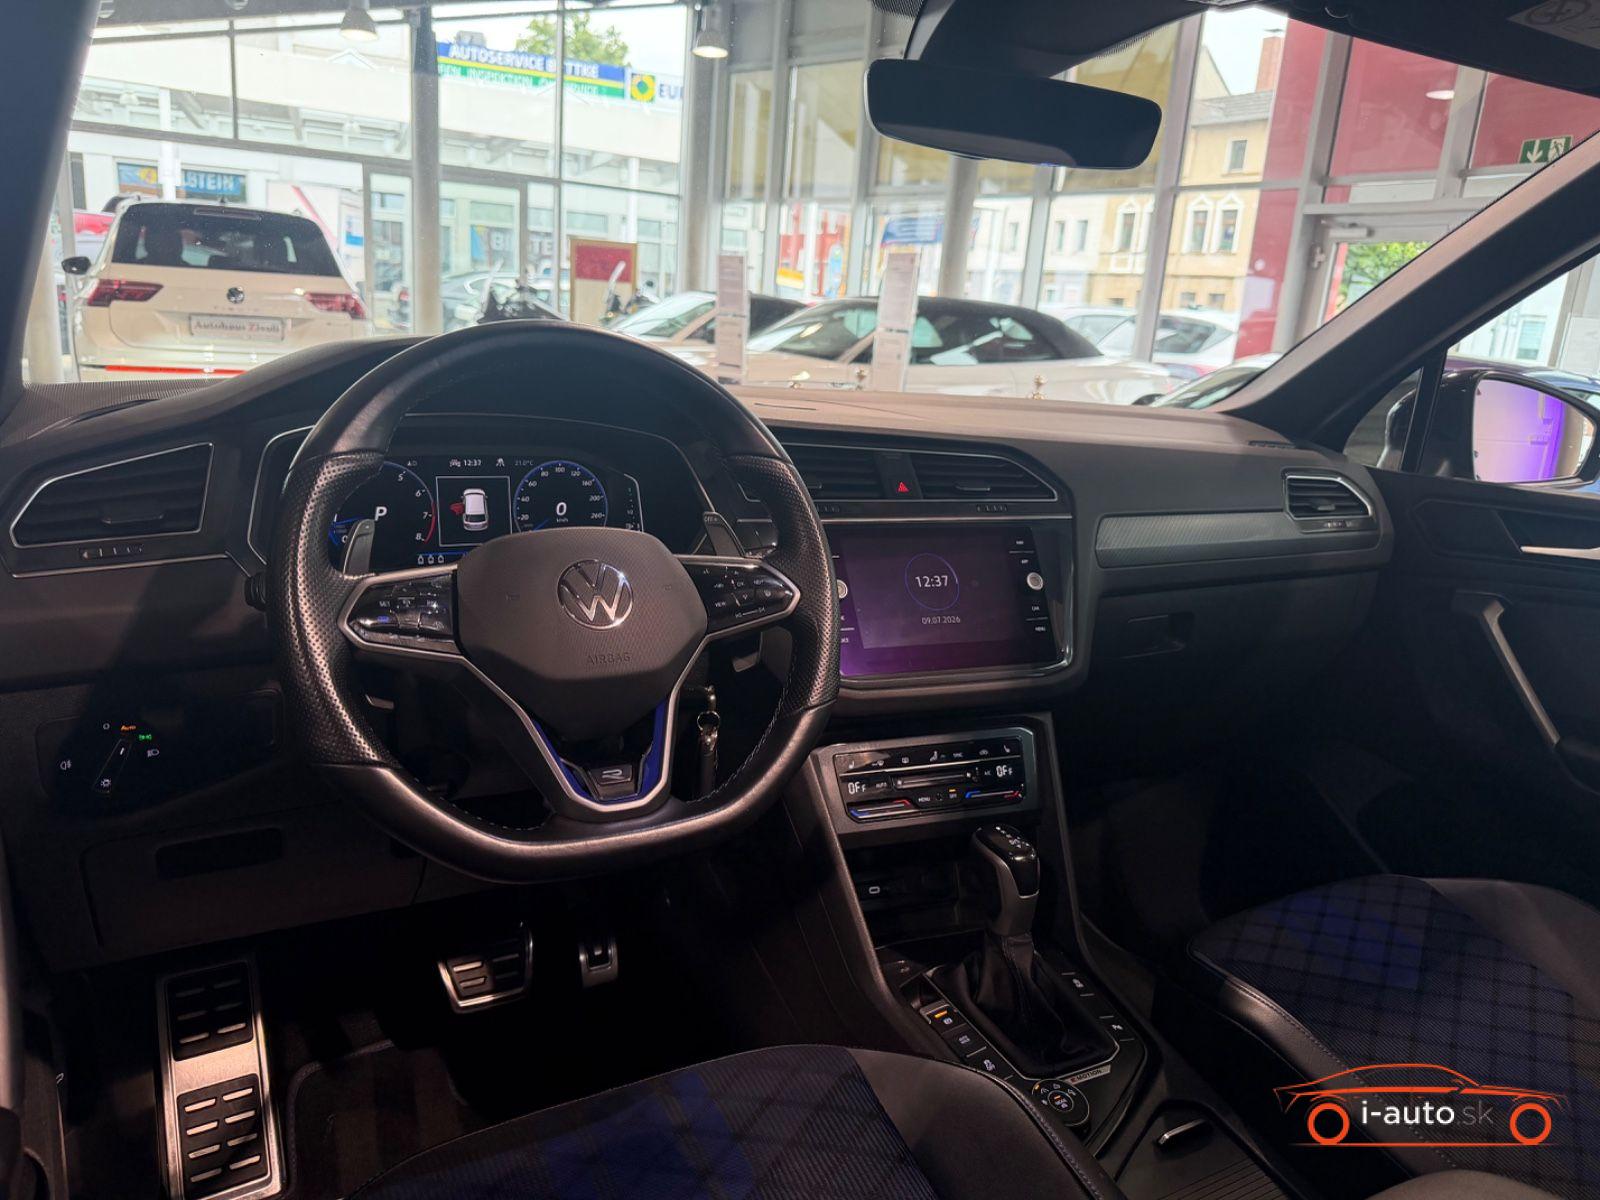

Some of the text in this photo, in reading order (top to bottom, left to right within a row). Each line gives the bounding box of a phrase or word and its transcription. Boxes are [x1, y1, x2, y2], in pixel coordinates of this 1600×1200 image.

[375, 506, 388, 521] P
[556, 502, 567, 516] 0
[915, 575, 948, 588] 12:37
[922, 615, 961, 624] 09.07.2026
[587, 653, 632, 665] AIRBAG
